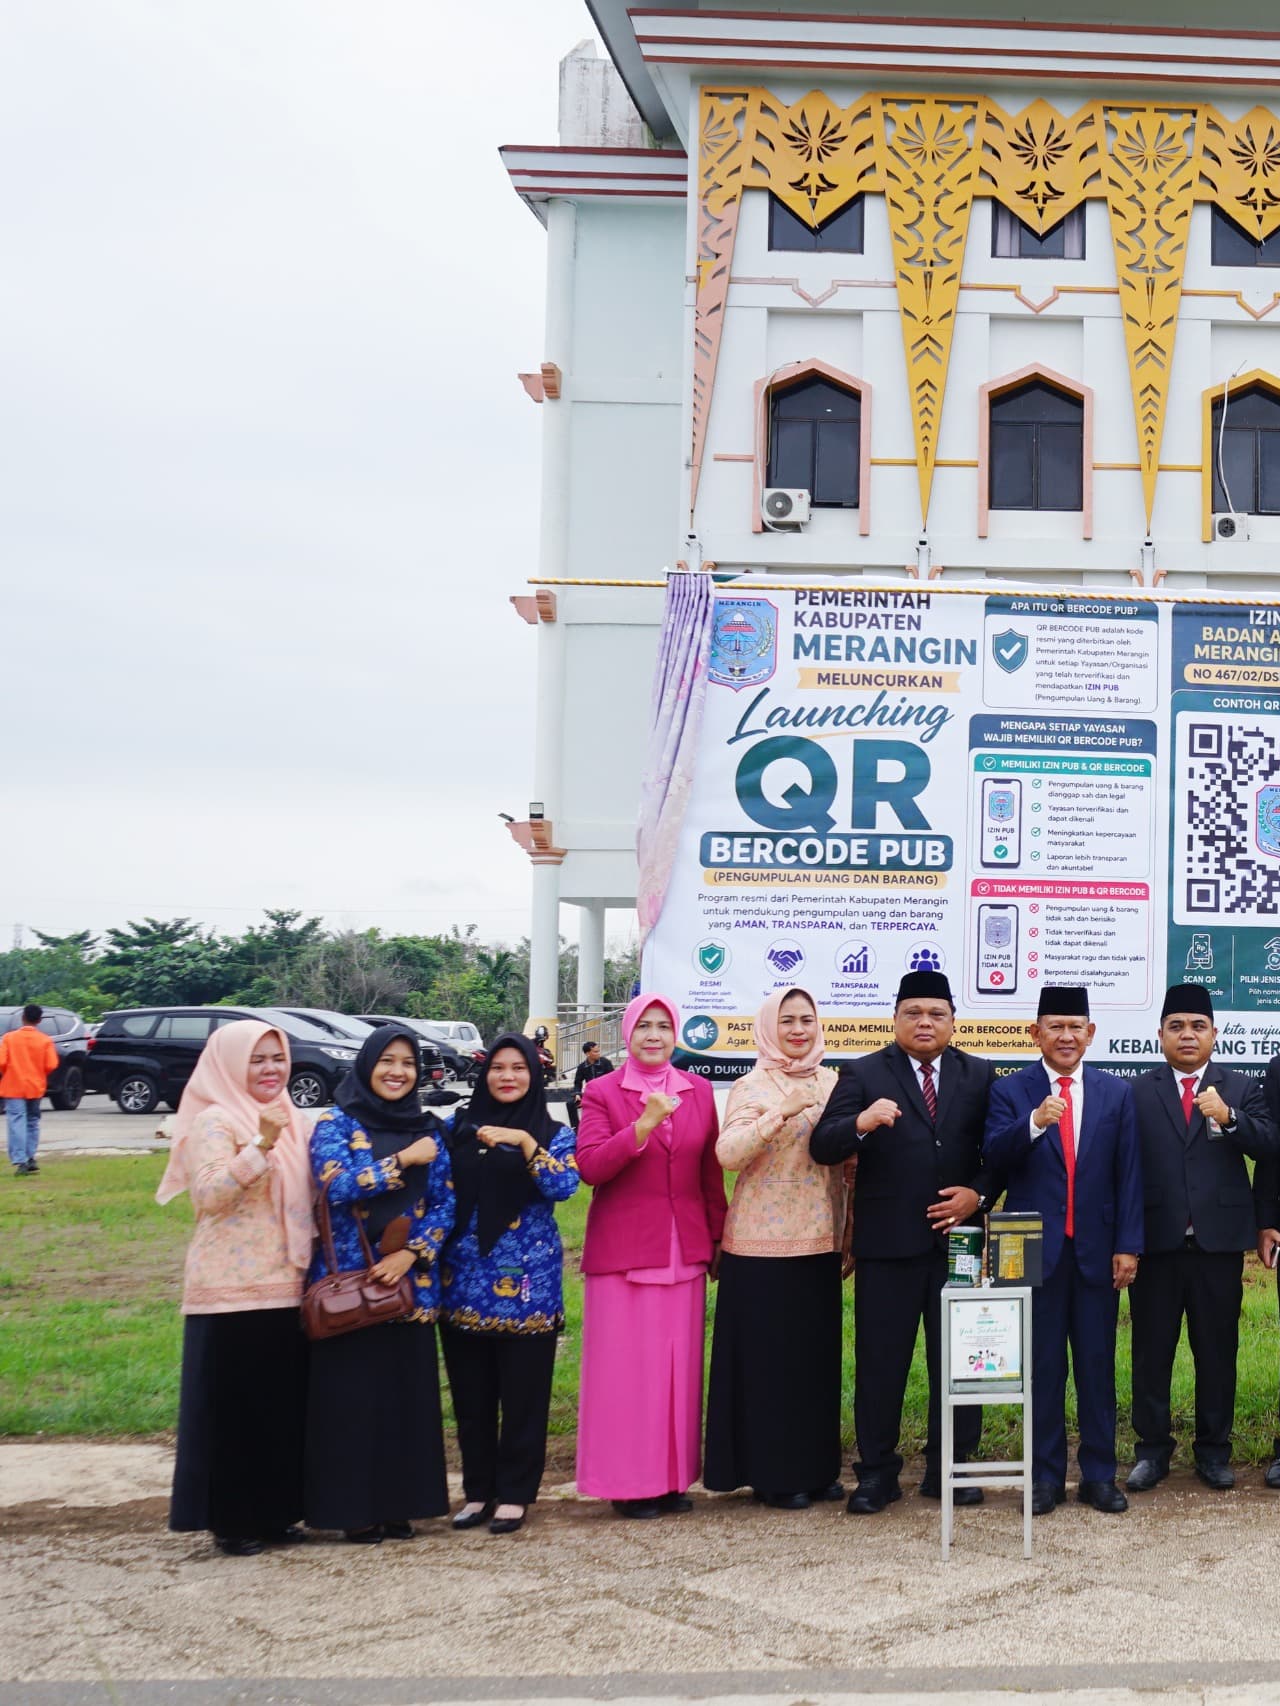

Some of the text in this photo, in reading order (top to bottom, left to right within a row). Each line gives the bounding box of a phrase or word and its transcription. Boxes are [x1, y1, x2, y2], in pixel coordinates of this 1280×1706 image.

[795, 590, 931, 610] PEMERINTAH
[1011, 602, 1138, 615] APA ITU QR BERCODE PUB?
[794, 611, 921, 631] KABUPATEN
[1202, 627, 1266, 643] BADAN
[793, 633, 977, 665] MERANGIN
[817, 672, 943, 688] MELUNCURKAN
[1194, 669, 1210, 678] NO
[1213, 698, 1261, 709] CONTOH
[1264, 700, 1279, 710] QR
[727, 687, 954, 745] Launching
[1001, 721, 1125, 733] MENGAPA SETIAP YAYASAN
[984, 733, 1142, 746] WAJIB MEMILIKI QR BERCODE PUB?
[1001, 760, 1040, 769] MEMILIKI
[1043, 761, 1059, 769] IZIN
[1062, 762, 1078, 770] PUB
[1090, 763, 1101, 771] QR
[1104, 763, 1144, 772] BERCODE
[735, 735, 932, 833] QR
[1048, 805, 1074, 813] Yayasan
[710, 837, 945, 866] BERCODE PUB
[714, 872, 938, 886] (PENGUMPULAN UANG DAN BARANG)
[993, 884, 1016, 893] TIDAK
[1019, 885, 1053, 893] MEMILIKI
[1055, 886, 1070, 894] IZIN
[1110, 888, 1145, 896] BERCODE
[698, 893, 948, 906] Program resmi dari Pemerintah Kabupaten Merangin
[703, 907, 943, 920] untuk mendukung pengumpulan uang dan barang
[709, 920, 939, 931] yang AMAN, TRANSPARAN, dan TERPERCAYA.
[728, 1023, 755, 1031] PAST
[960, 1026, 973, 1034] QR
[977, 1026, 1022, 1034] BERCODE
[1223, 1022, 1247, 1035] kita
[727, 1037, 749, 1047] Agar
[956, 1040, 983, 1049] penuh
[1109, 1039, 1163, 1054] KEBAI
[1213, 1041, 1246, 1055] ANG
[688, 1066, 753, 1074] AYO DUKUN
